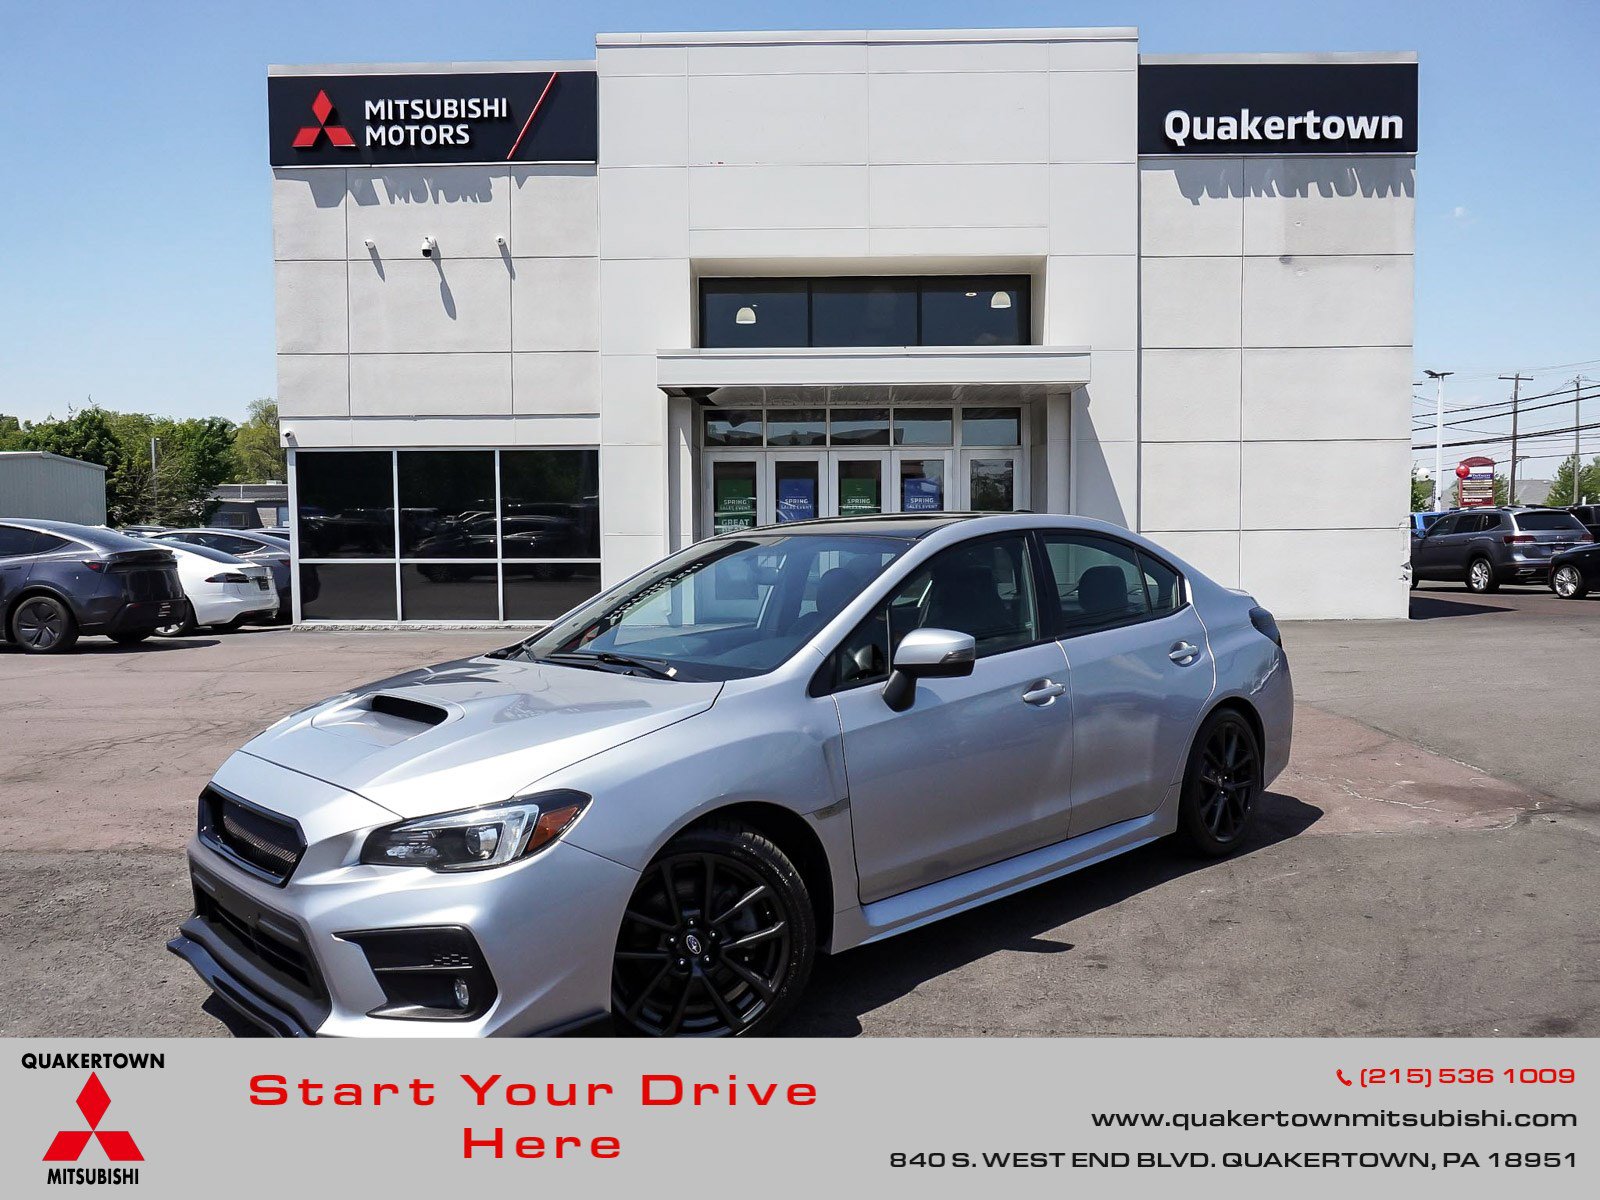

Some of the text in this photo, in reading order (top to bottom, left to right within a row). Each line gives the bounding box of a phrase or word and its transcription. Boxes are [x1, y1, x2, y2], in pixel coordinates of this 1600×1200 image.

[365, 98, 507, 120] MITSUBISHI
[365, 124, 470, 146] MOTORS
[1164, 108, 1404, 147] Quakertown
[721, 518, 750, 526] GREAT
